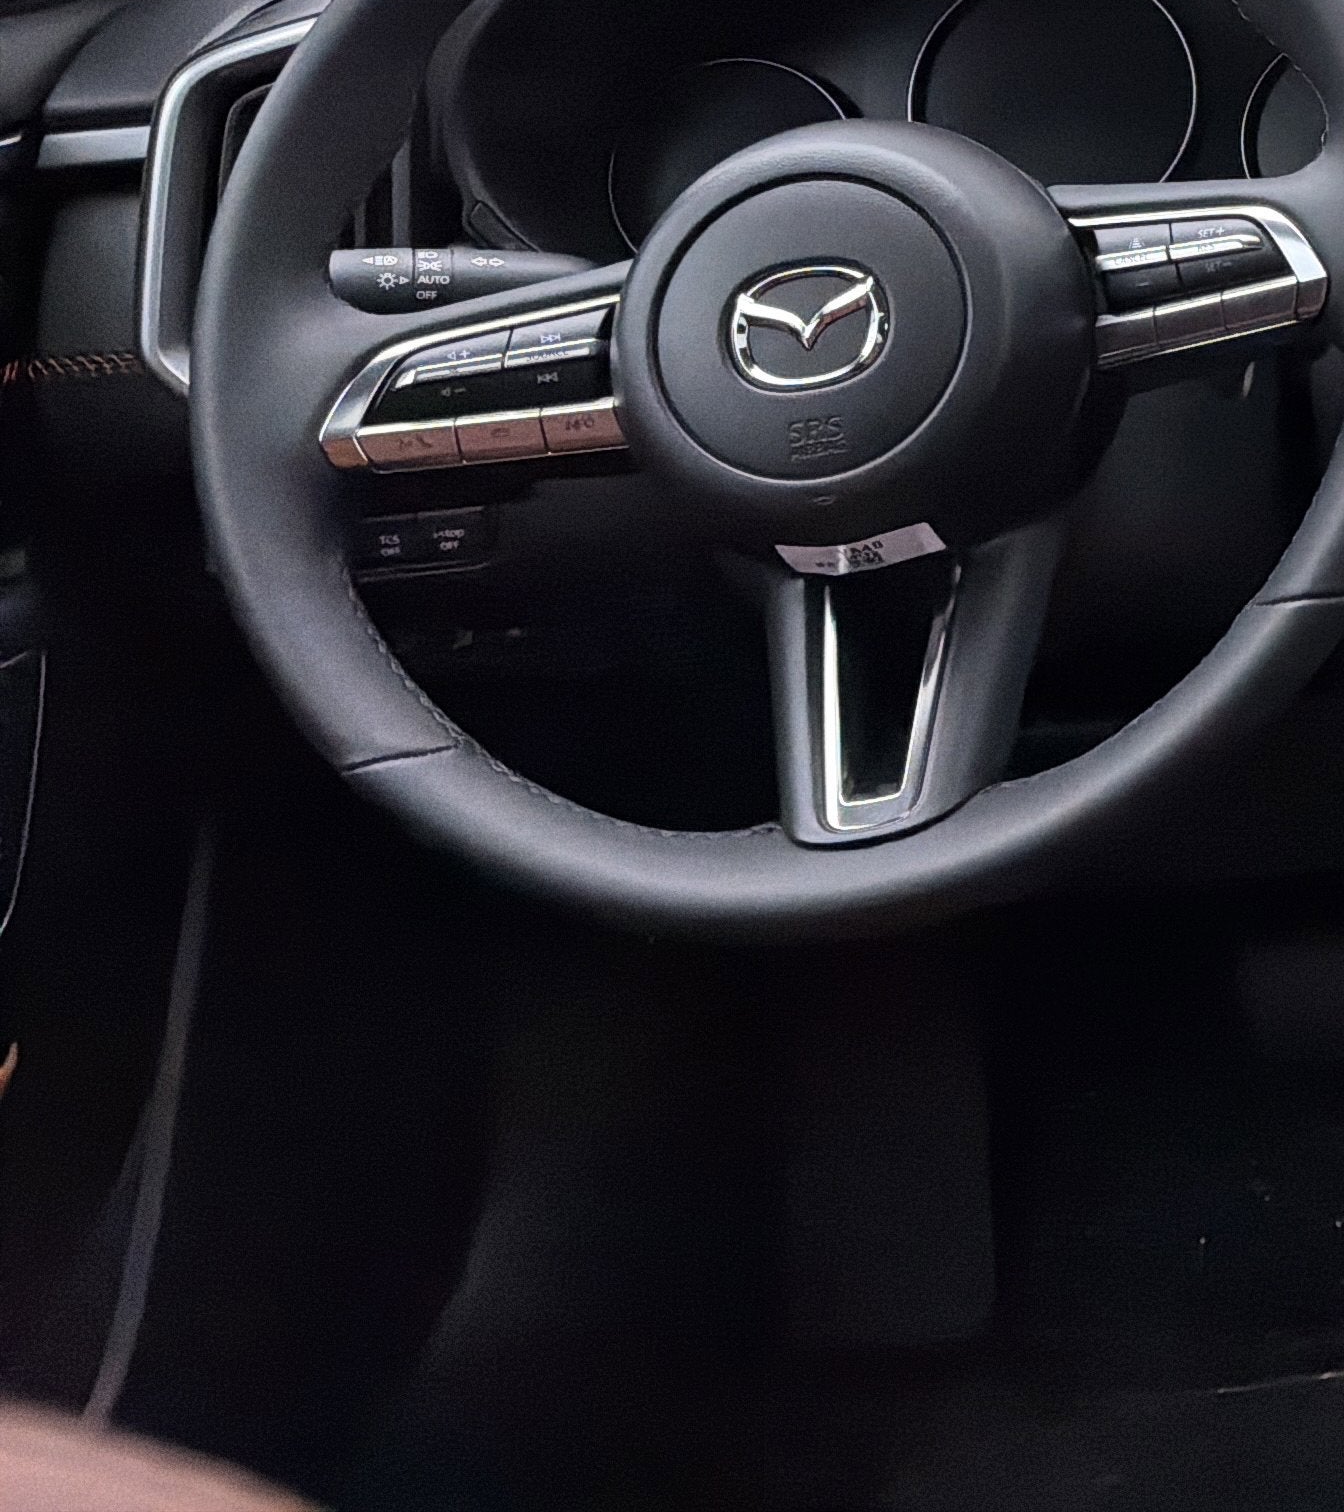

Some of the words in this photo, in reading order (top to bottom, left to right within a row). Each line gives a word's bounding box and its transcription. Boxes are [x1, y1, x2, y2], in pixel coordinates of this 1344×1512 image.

[417, 275, 450, 285] AUTO
[416, 290, 438, 300] OFF
[790, 416, 844, 447] SRS
[379, 535, 400, 545] TCS
